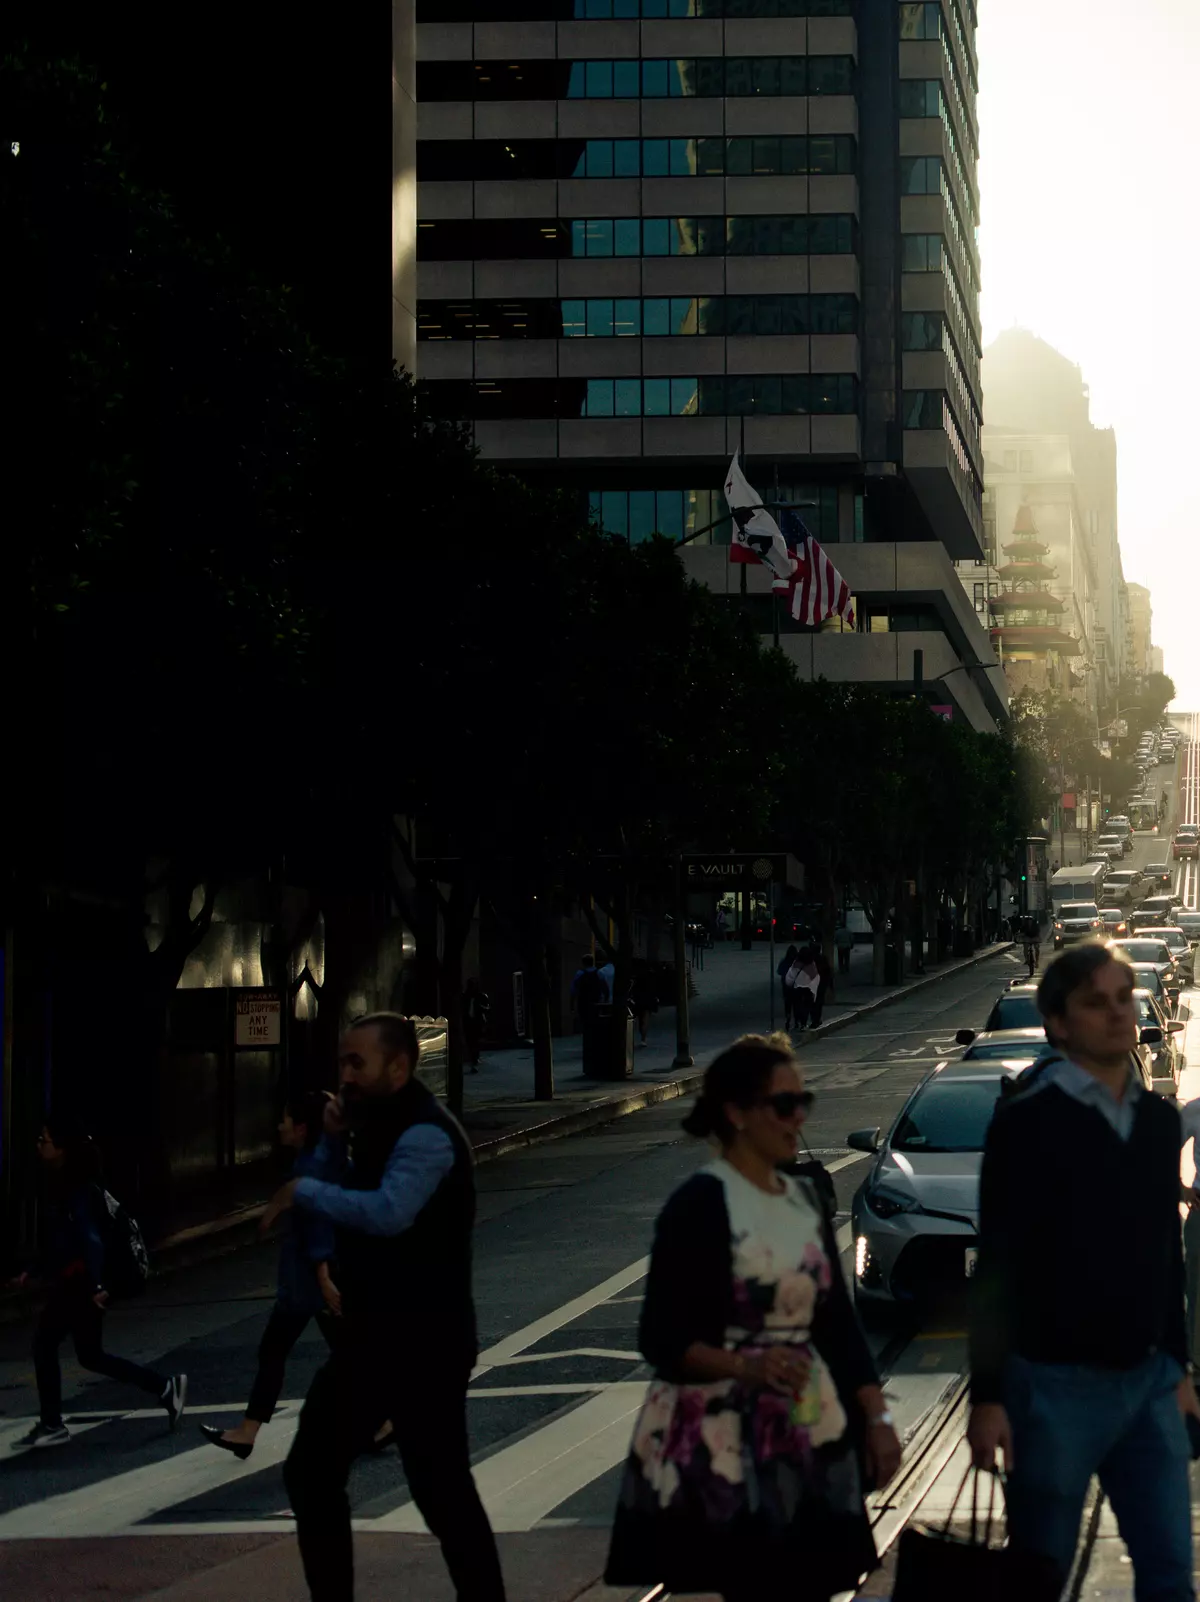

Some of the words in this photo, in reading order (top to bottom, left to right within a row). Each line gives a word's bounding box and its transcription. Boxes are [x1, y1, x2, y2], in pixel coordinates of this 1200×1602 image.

[700, 864, 746, 875] VAULT
[237, 1001, 248, 1013] NO
[250, 1002, 279, 1013] STOPPING
[249, 1015, 267, 1025] ANY
[248, 1026, 269, 1036] TIME
